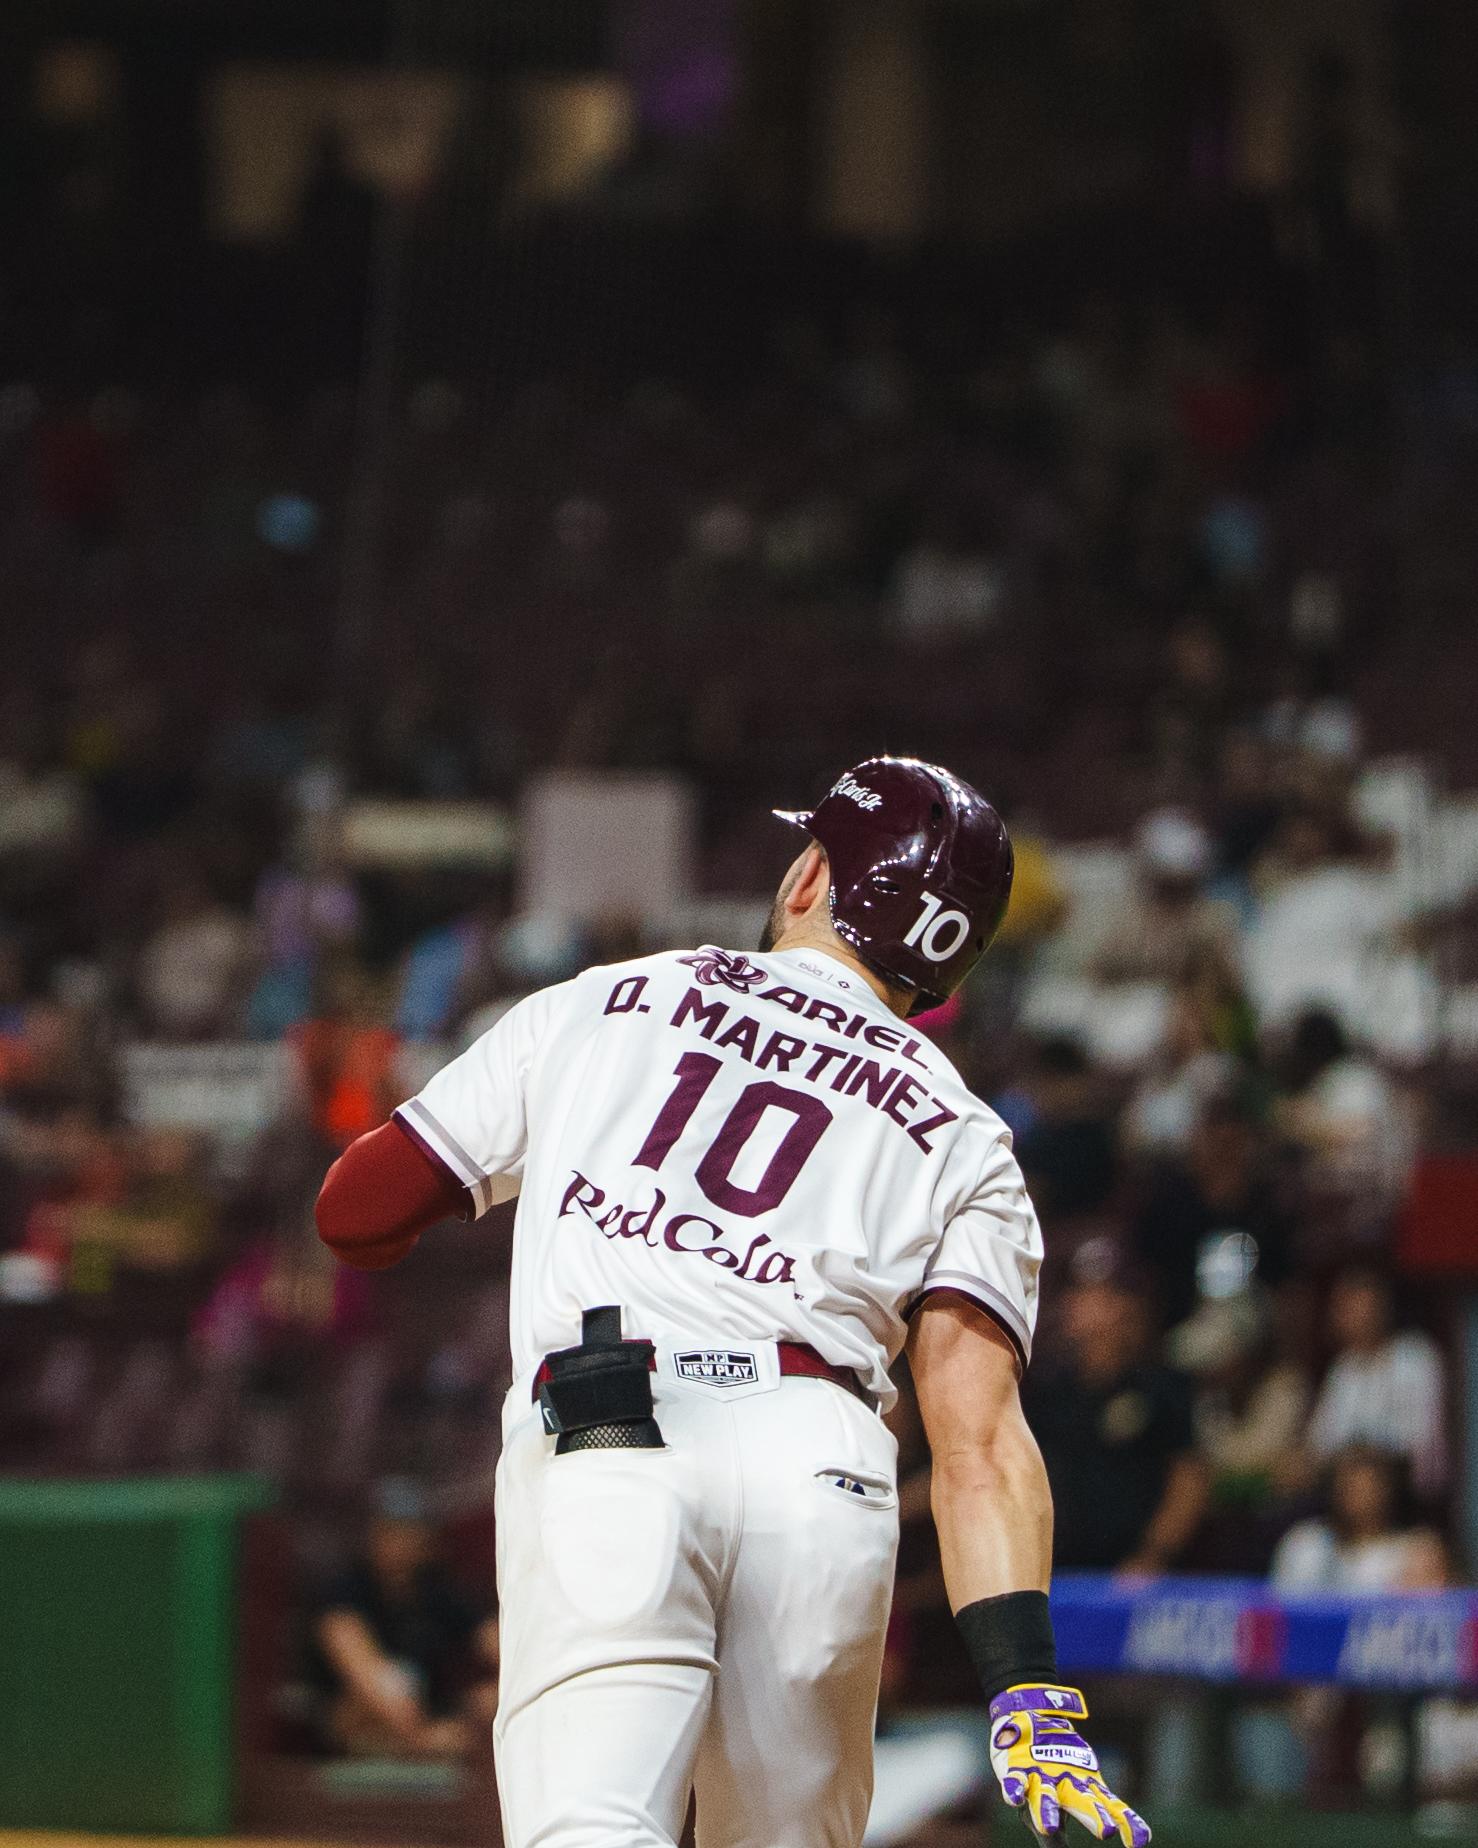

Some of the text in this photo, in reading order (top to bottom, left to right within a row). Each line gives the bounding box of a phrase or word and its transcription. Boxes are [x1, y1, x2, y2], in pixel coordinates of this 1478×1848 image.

[902, 890, 970, 962] 10
[603, 975, 959, 1156] D. MARTINEZ
[755, 986, 929, 1070] ARIEL
[630, 1051, 834, 1218] 10
[683, 1364, 750, 1379] NEW PLAY
